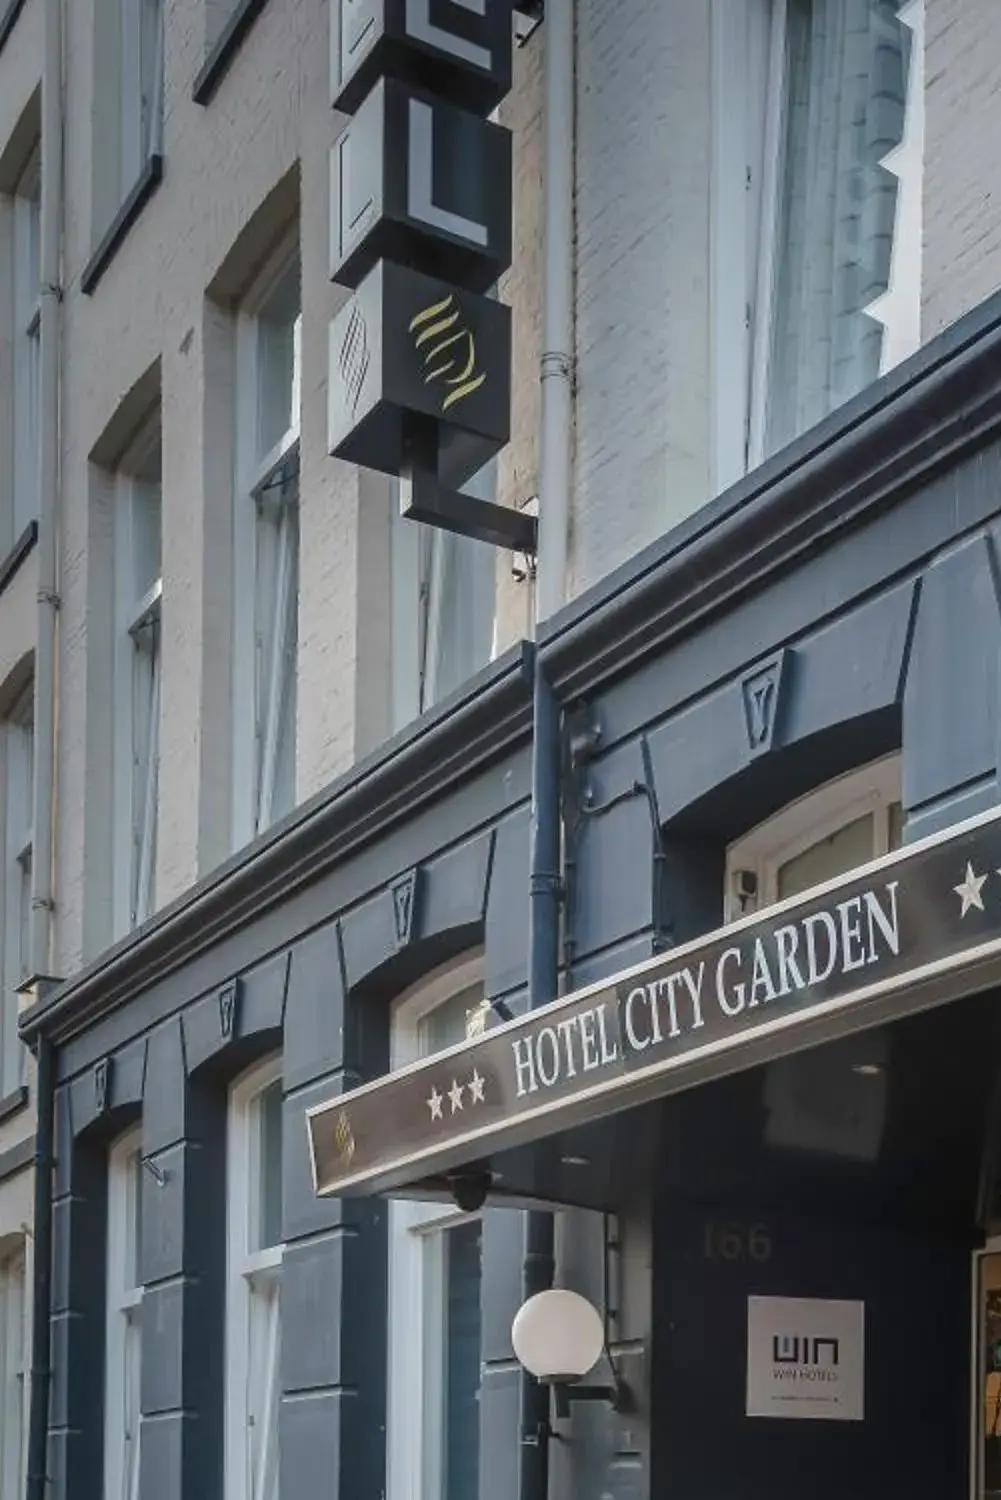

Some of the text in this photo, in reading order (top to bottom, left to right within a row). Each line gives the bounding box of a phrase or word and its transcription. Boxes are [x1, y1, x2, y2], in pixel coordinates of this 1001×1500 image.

[511, 880, 901, 1098] HOTEL CITY GARDEN
